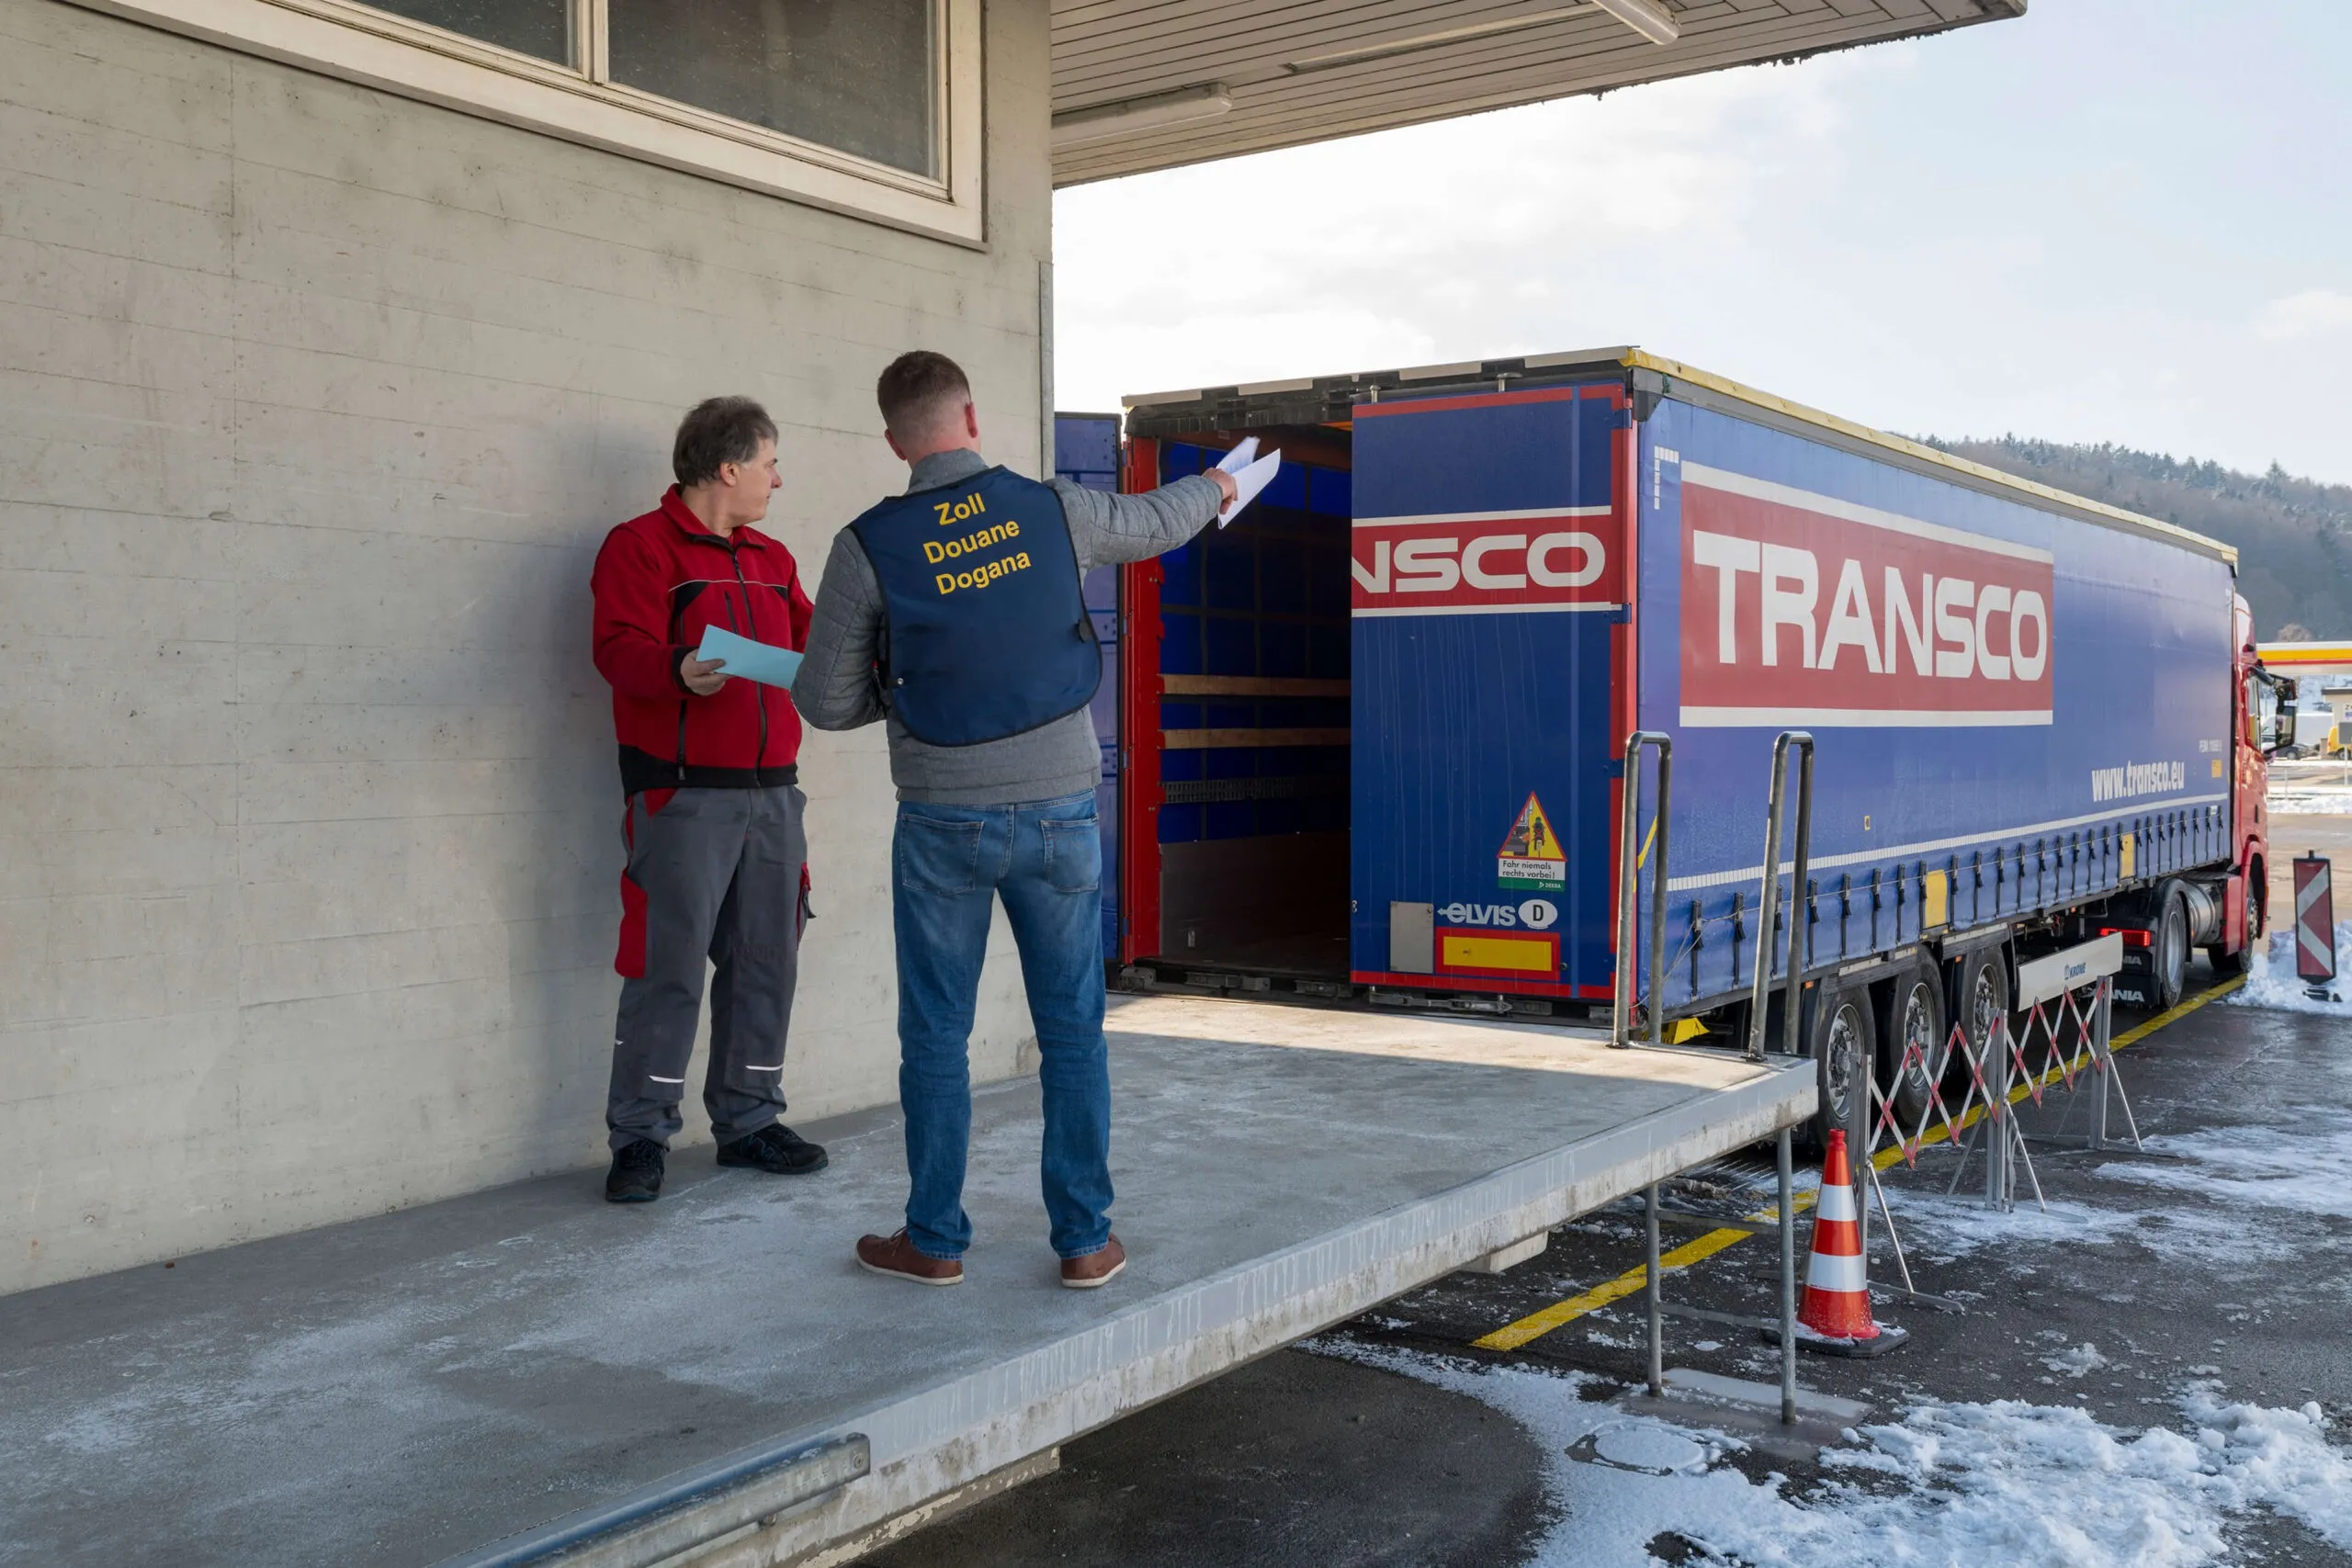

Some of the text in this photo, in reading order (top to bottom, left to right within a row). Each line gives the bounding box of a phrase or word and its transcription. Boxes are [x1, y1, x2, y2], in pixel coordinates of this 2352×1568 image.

[933, 492, 986, 526] Zoll
[922, 519, 1021, 564] Douane
[935, 551, 1032, 595] Dogana
[1693, 530, 2048, 681] TRANSCO
[2091, 760, 2185, 803] www.transco.eu
[1502, 860, 1552, 870] Fahr niemals
[1502, 869, 1555, 879] rechts vorbei!
[1532, 905, 1544, 921] D
